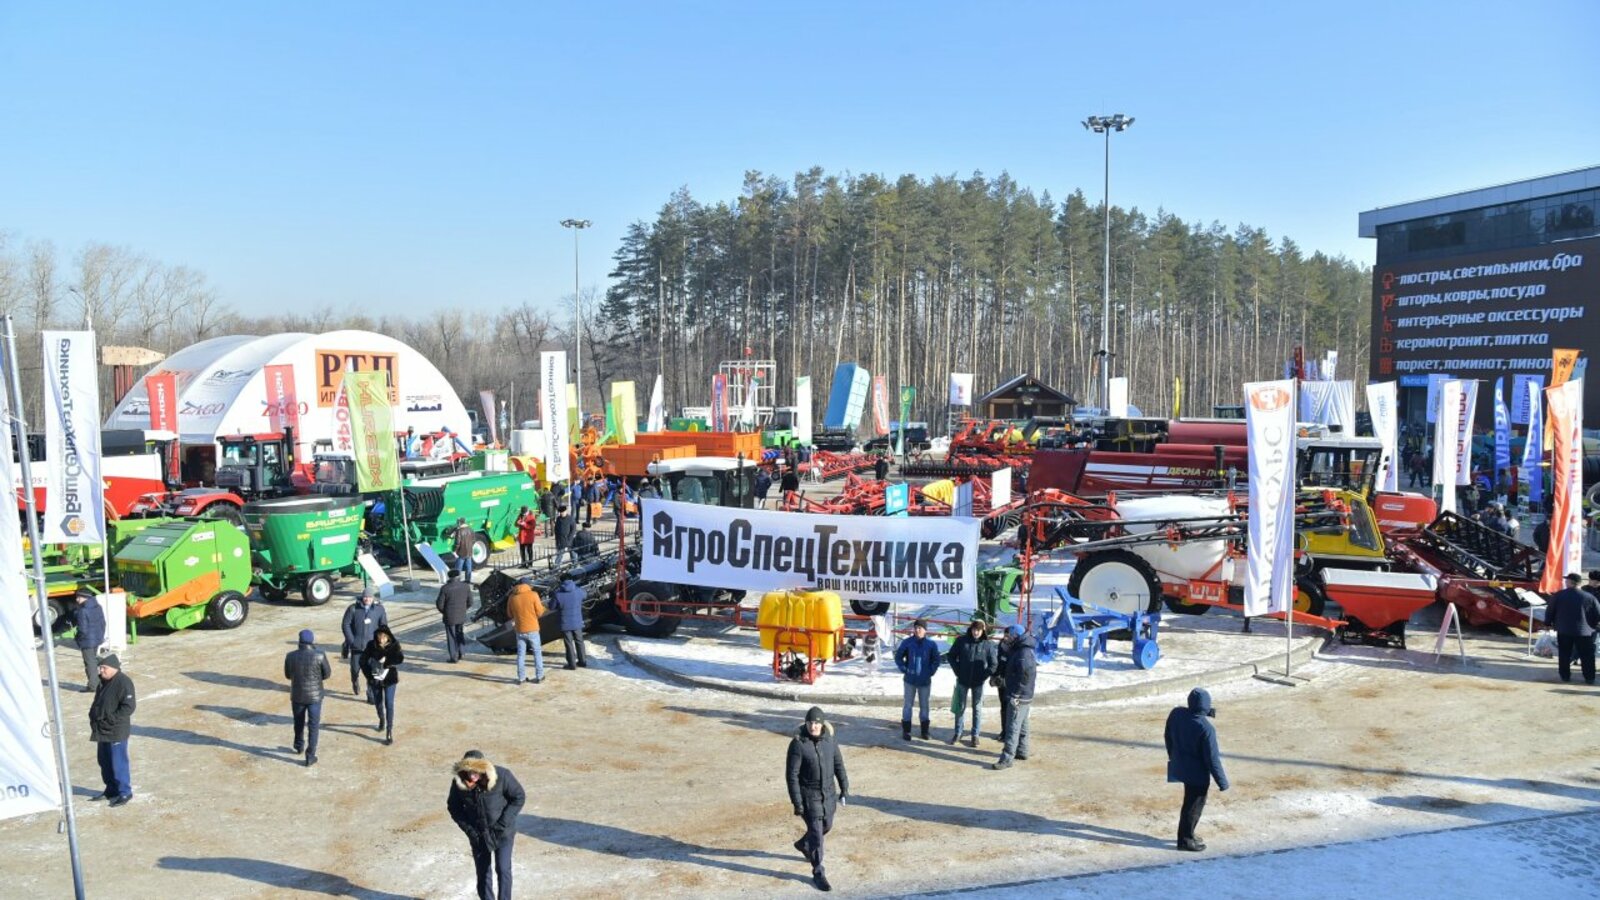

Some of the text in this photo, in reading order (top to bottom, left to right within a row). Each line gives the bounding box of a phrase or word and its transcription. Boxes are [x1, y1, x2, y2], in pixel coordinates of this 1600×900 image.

[1397, 307, 1585, 329] интерьерные аксессуары
[652, 510, 965, 582] АгроСпецТехника
[817, 577, 964, 595] ВАШ НАДЕЖНЫЙ ПАРТНЕР
